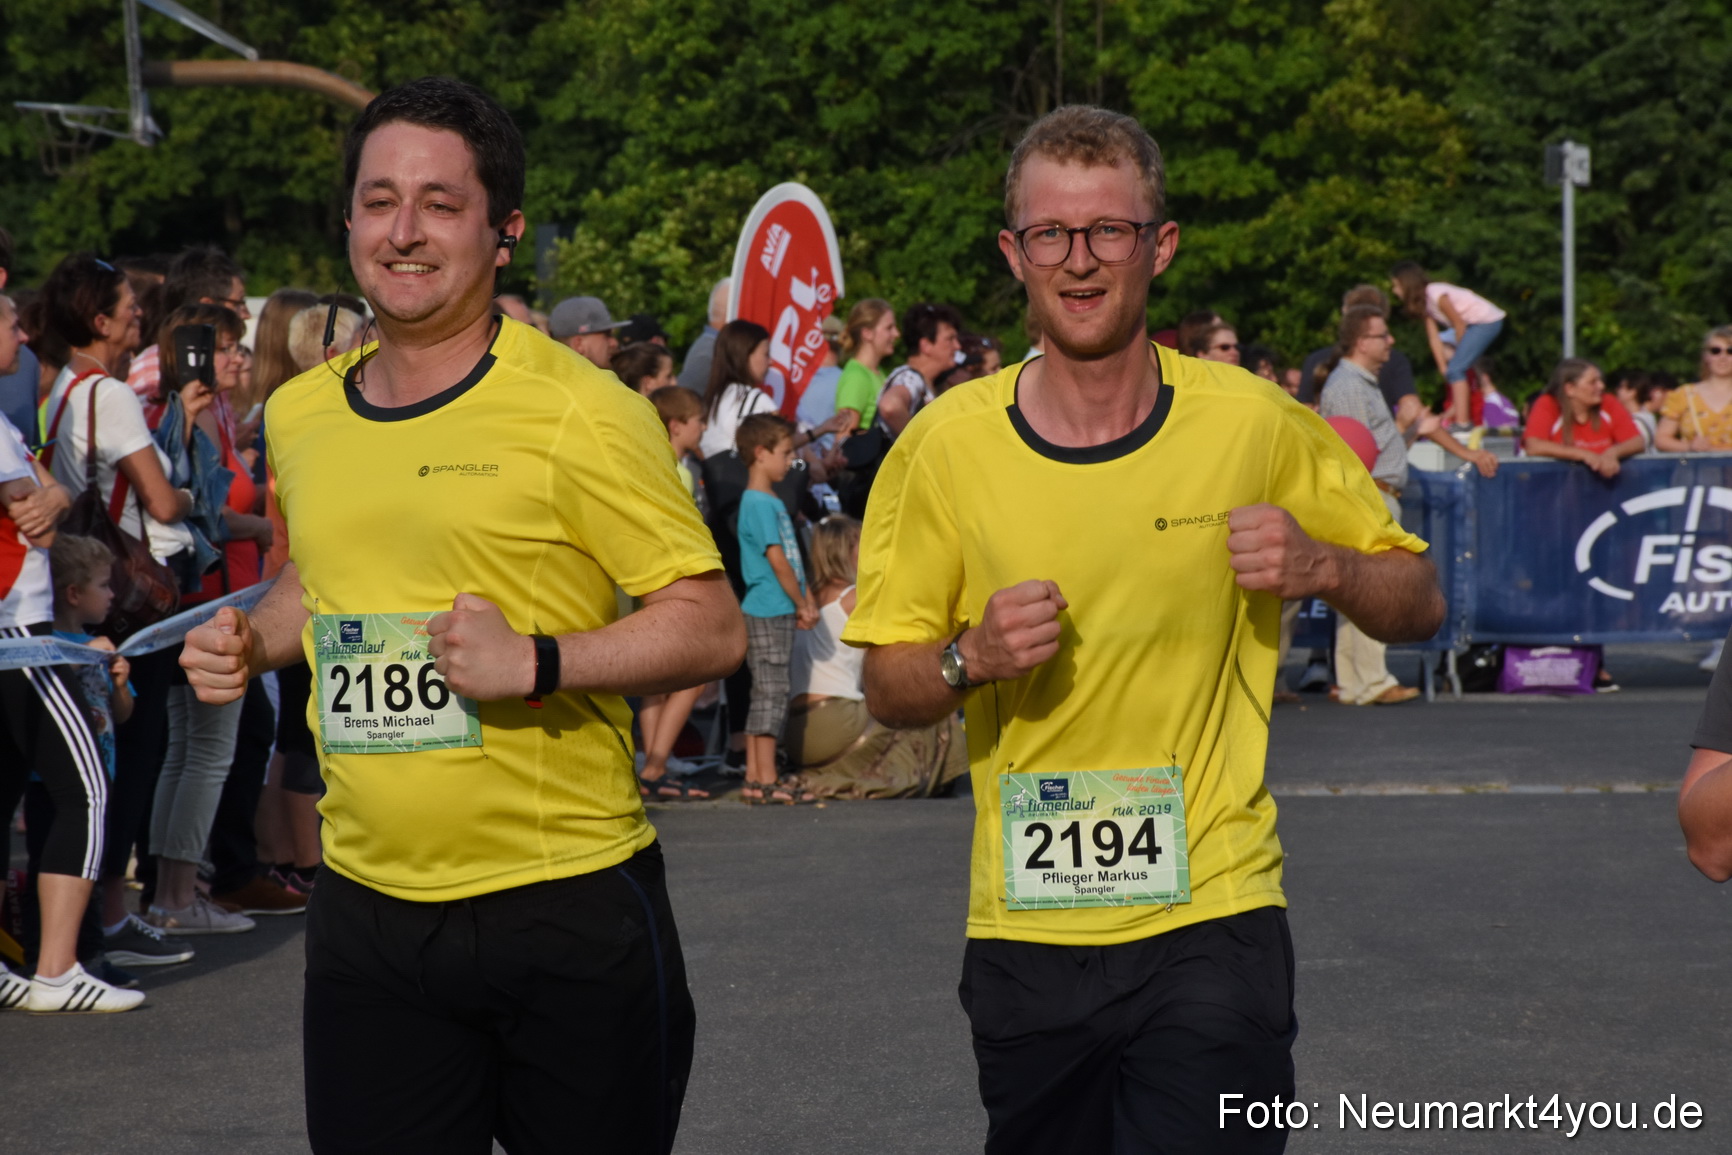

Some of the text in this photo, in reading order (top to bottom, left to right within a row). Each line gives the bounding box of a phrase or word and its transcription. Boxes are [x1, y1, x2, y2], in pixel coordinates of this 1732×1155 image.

[432, 463, 499, 474] SPANGLER
[331, 640, 386, 654] firmenlauf
[330, 662, 450, 713] 2186
[344, 714, 435, 728] Brems Michael
[366, 730, 405, 741] Spangler
[1028, 797, 1096, 812] firmenlauf
[1139, 803, 1172, 816] 2019
[1024, 817, 1162, 870] 2194
[1042, 869, 1149, 886] Pflieger Markus
[1074, 885, 1116, 896] Spangler
